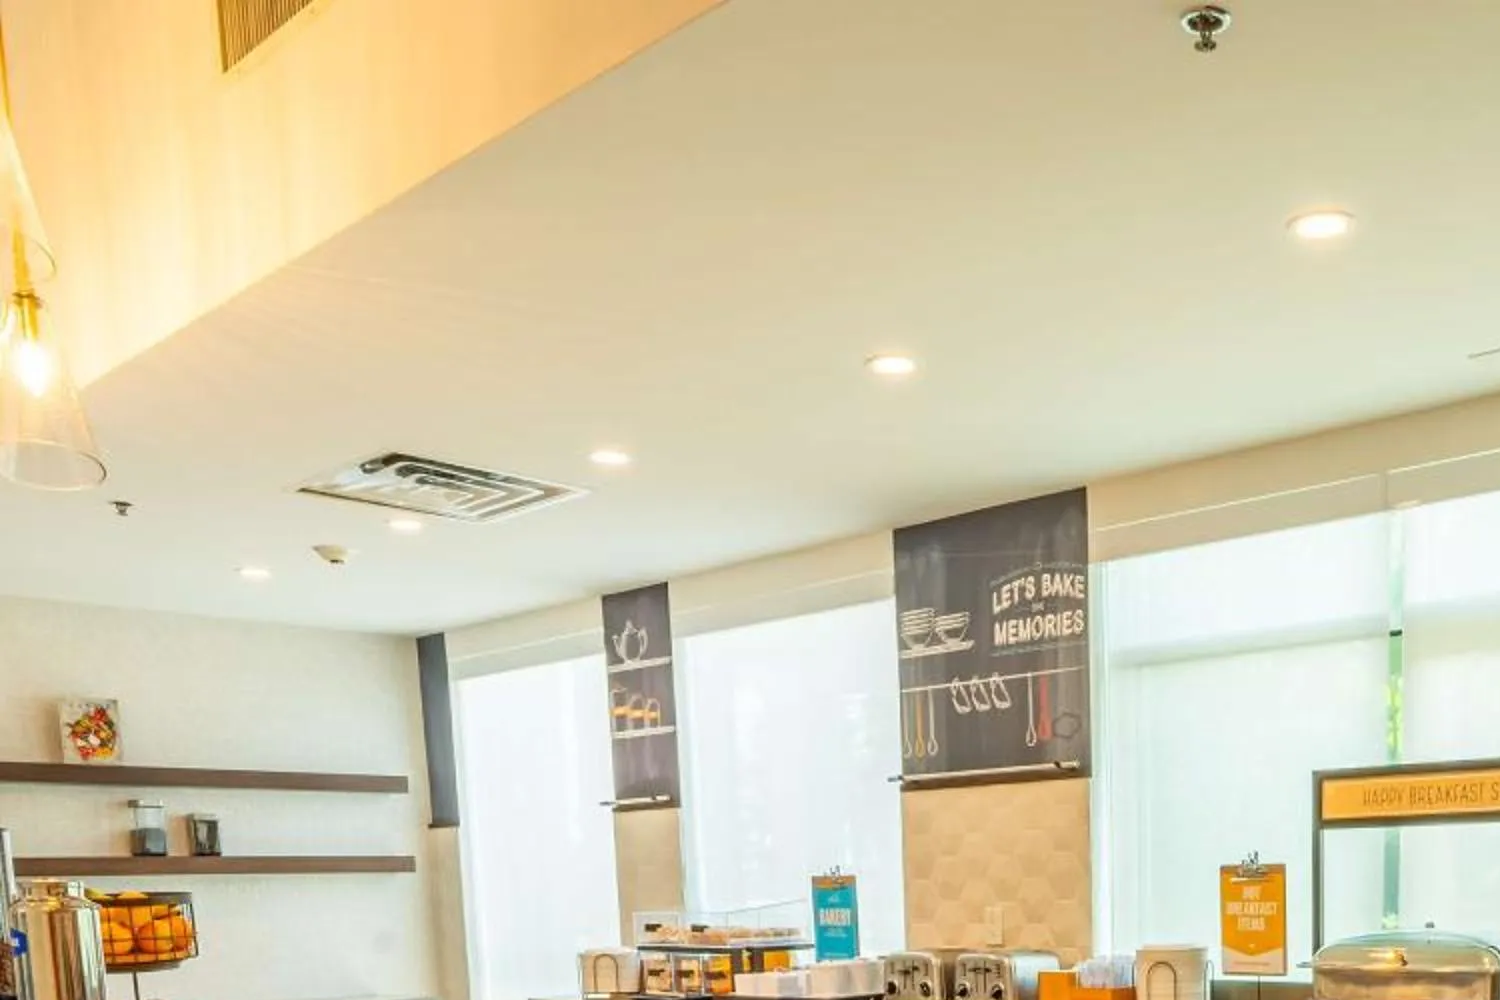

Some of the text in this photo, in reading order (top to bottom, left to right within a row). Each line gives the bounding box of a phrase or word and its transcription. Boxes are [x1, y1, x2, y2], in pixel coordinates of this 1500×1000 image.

[992, 573, 1085, 615] LET'S BAKE
[994, 609, 1085, 646] MEMORIES
[1362, 787, 1403, 806] HAPPY
[1408, 781, 1486, 805] BREAKFAST
[819, 907, 851, 927] BAKERY
